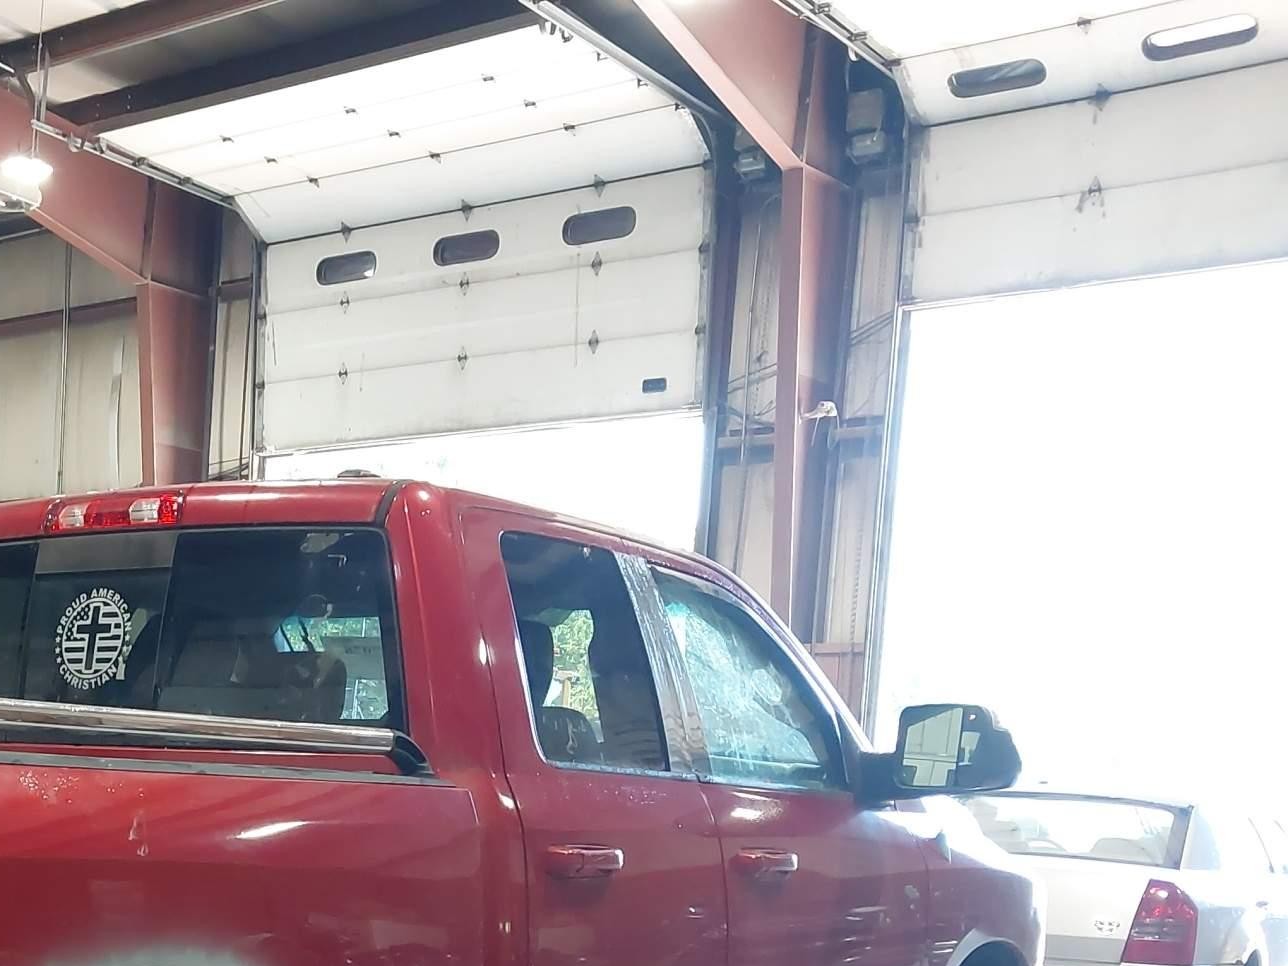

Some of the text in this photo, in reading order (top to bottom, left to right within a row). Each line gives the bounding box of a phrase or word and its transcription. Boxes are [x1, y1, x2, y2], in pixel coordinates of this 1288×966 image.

[56, 587, 133, 635] PROUD AMERICAN
[59, 664, 117, 690] CHRISTIAN
